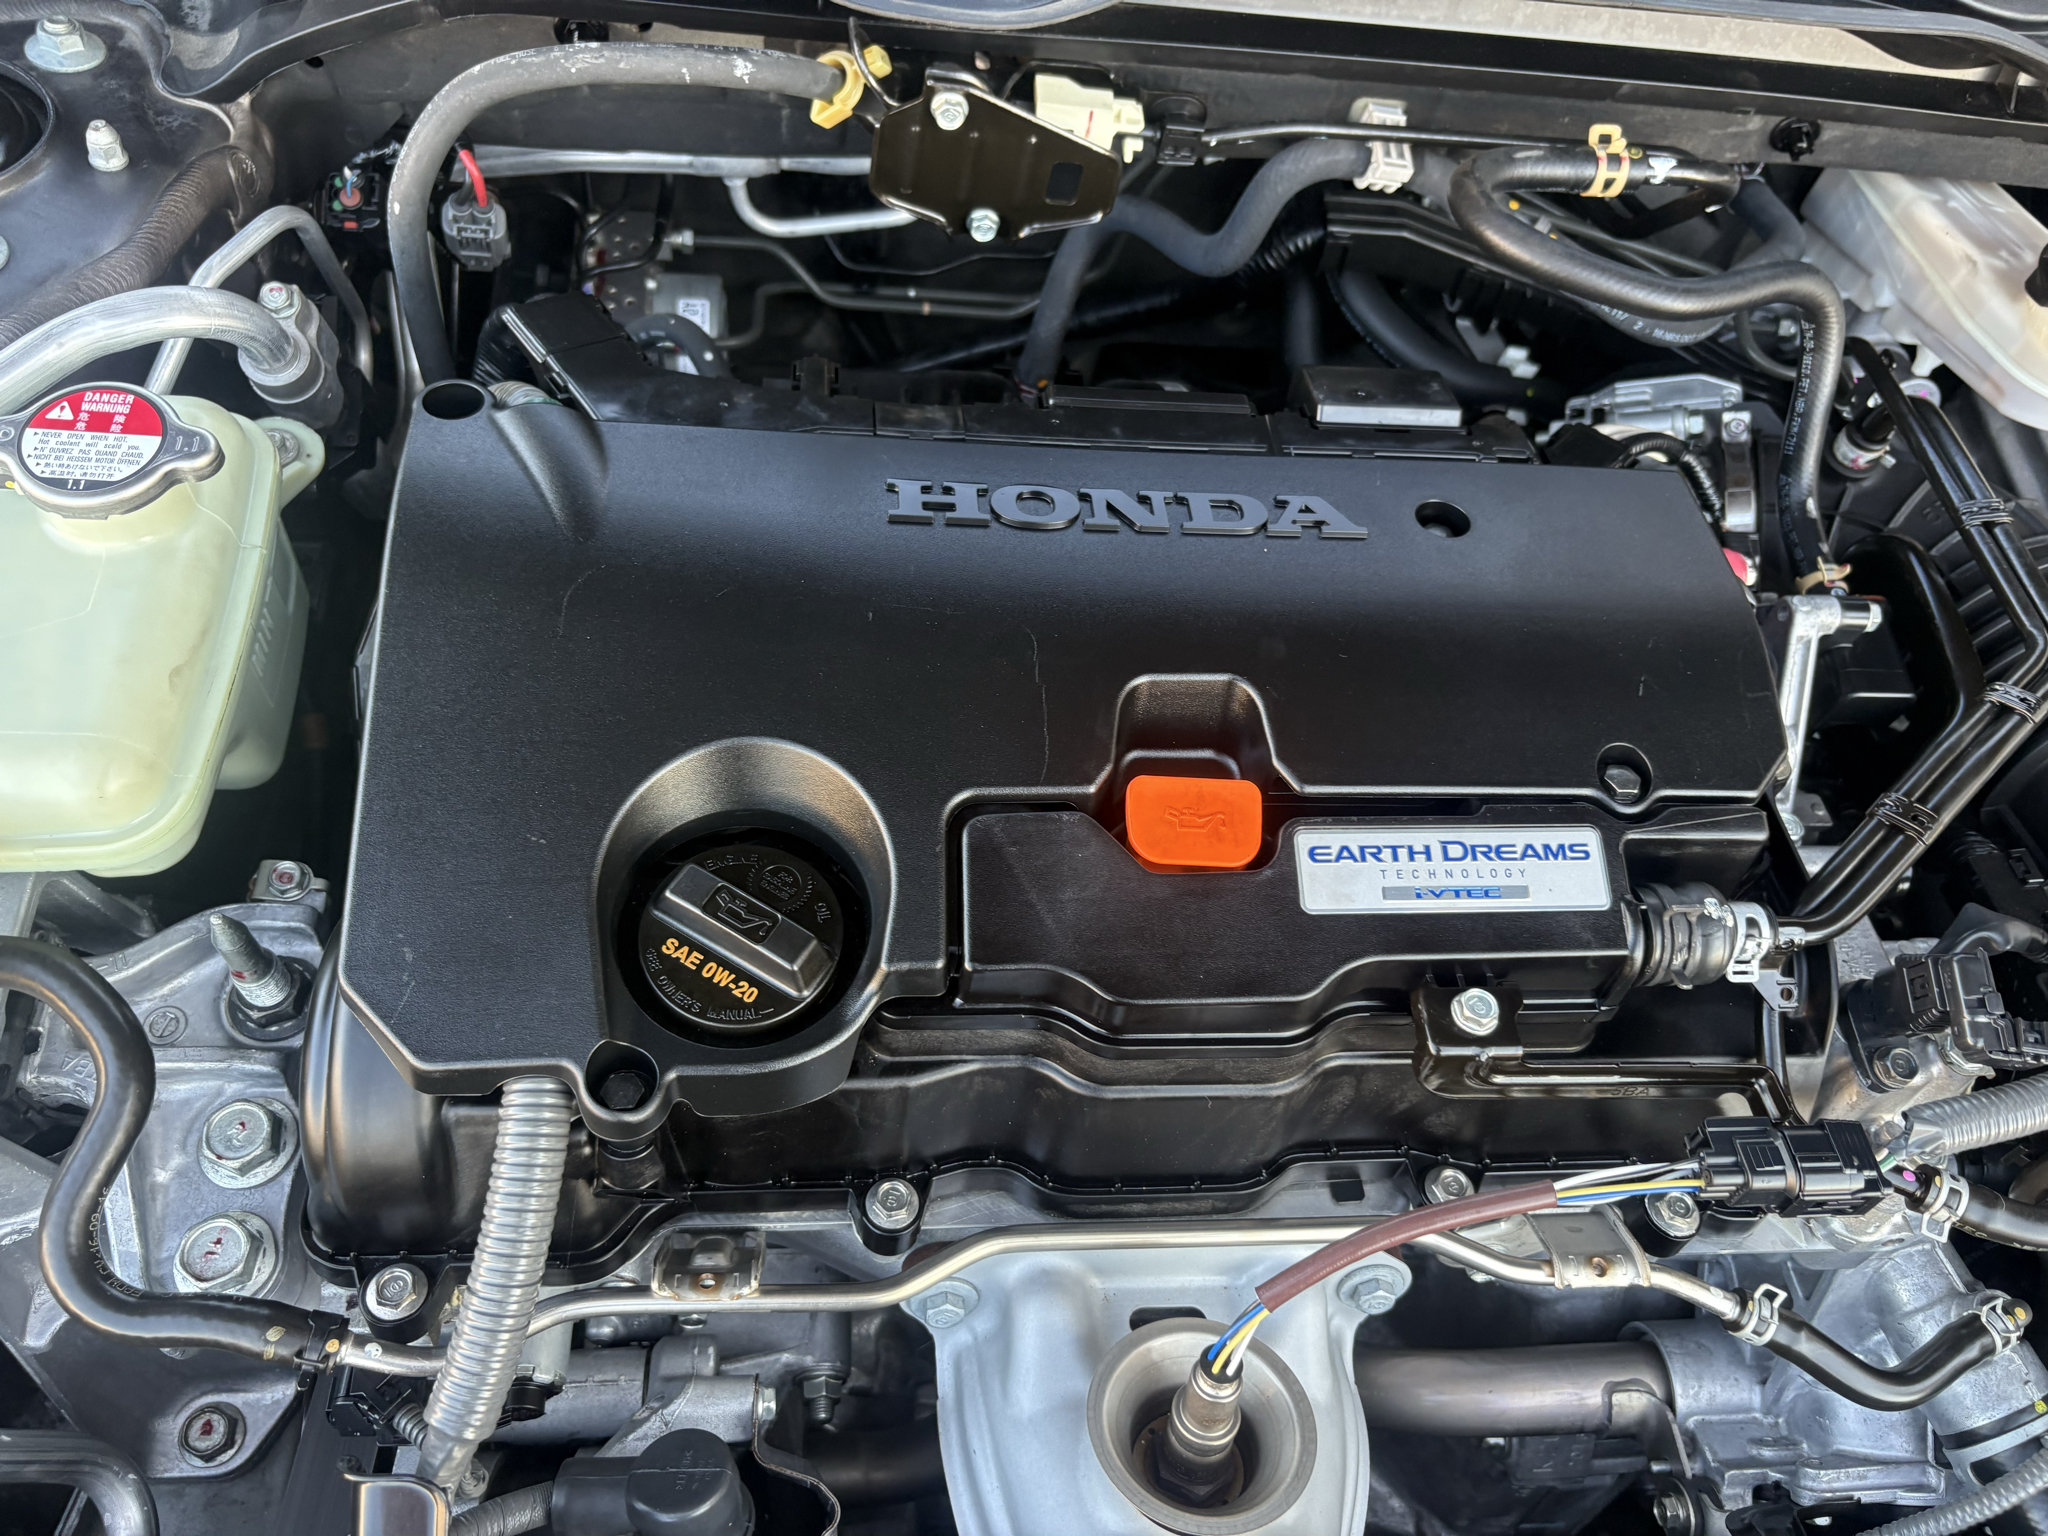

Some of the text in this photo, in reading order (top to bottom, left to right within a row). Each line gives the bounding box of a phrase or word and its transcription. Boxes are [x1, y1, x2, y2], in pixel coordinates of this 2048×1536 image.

[83, 392, 135, 405] DANGER
[81, 401, 131, 414] WARNUNG
[41, 431, 128, 443] NEVER OPEN WHEN HOT.
[175, 436, 200, 451] 1.1
[38, 438, 51, 446] Hot
[55, 439, 81, 448] coolant
[127, 444, 141, 452] you.
[33, 453, 51, 461] NICHT
[53, 454, 65, 462] BEI
[67, 455, 93, 464] HEISSEM
[95, 457, 115, 465] MOTOR
[49, 447, 74, 455] OUVREZ
[95, 450, 118, 458] QUAND
[121, 452, 144, 460] CHAUD.
[67, 479, 85, 490] 1.1
[885, 478, 1368, 539] HONDA
[1308, 839, 1592, 864] EARTH DREAMS
[1380, 868, 1526, 880] TECHNOLOGY
[1414, 885, 1502, 900] i-VTEC
[661, 937, 759, 1004] SAE 0W-20
